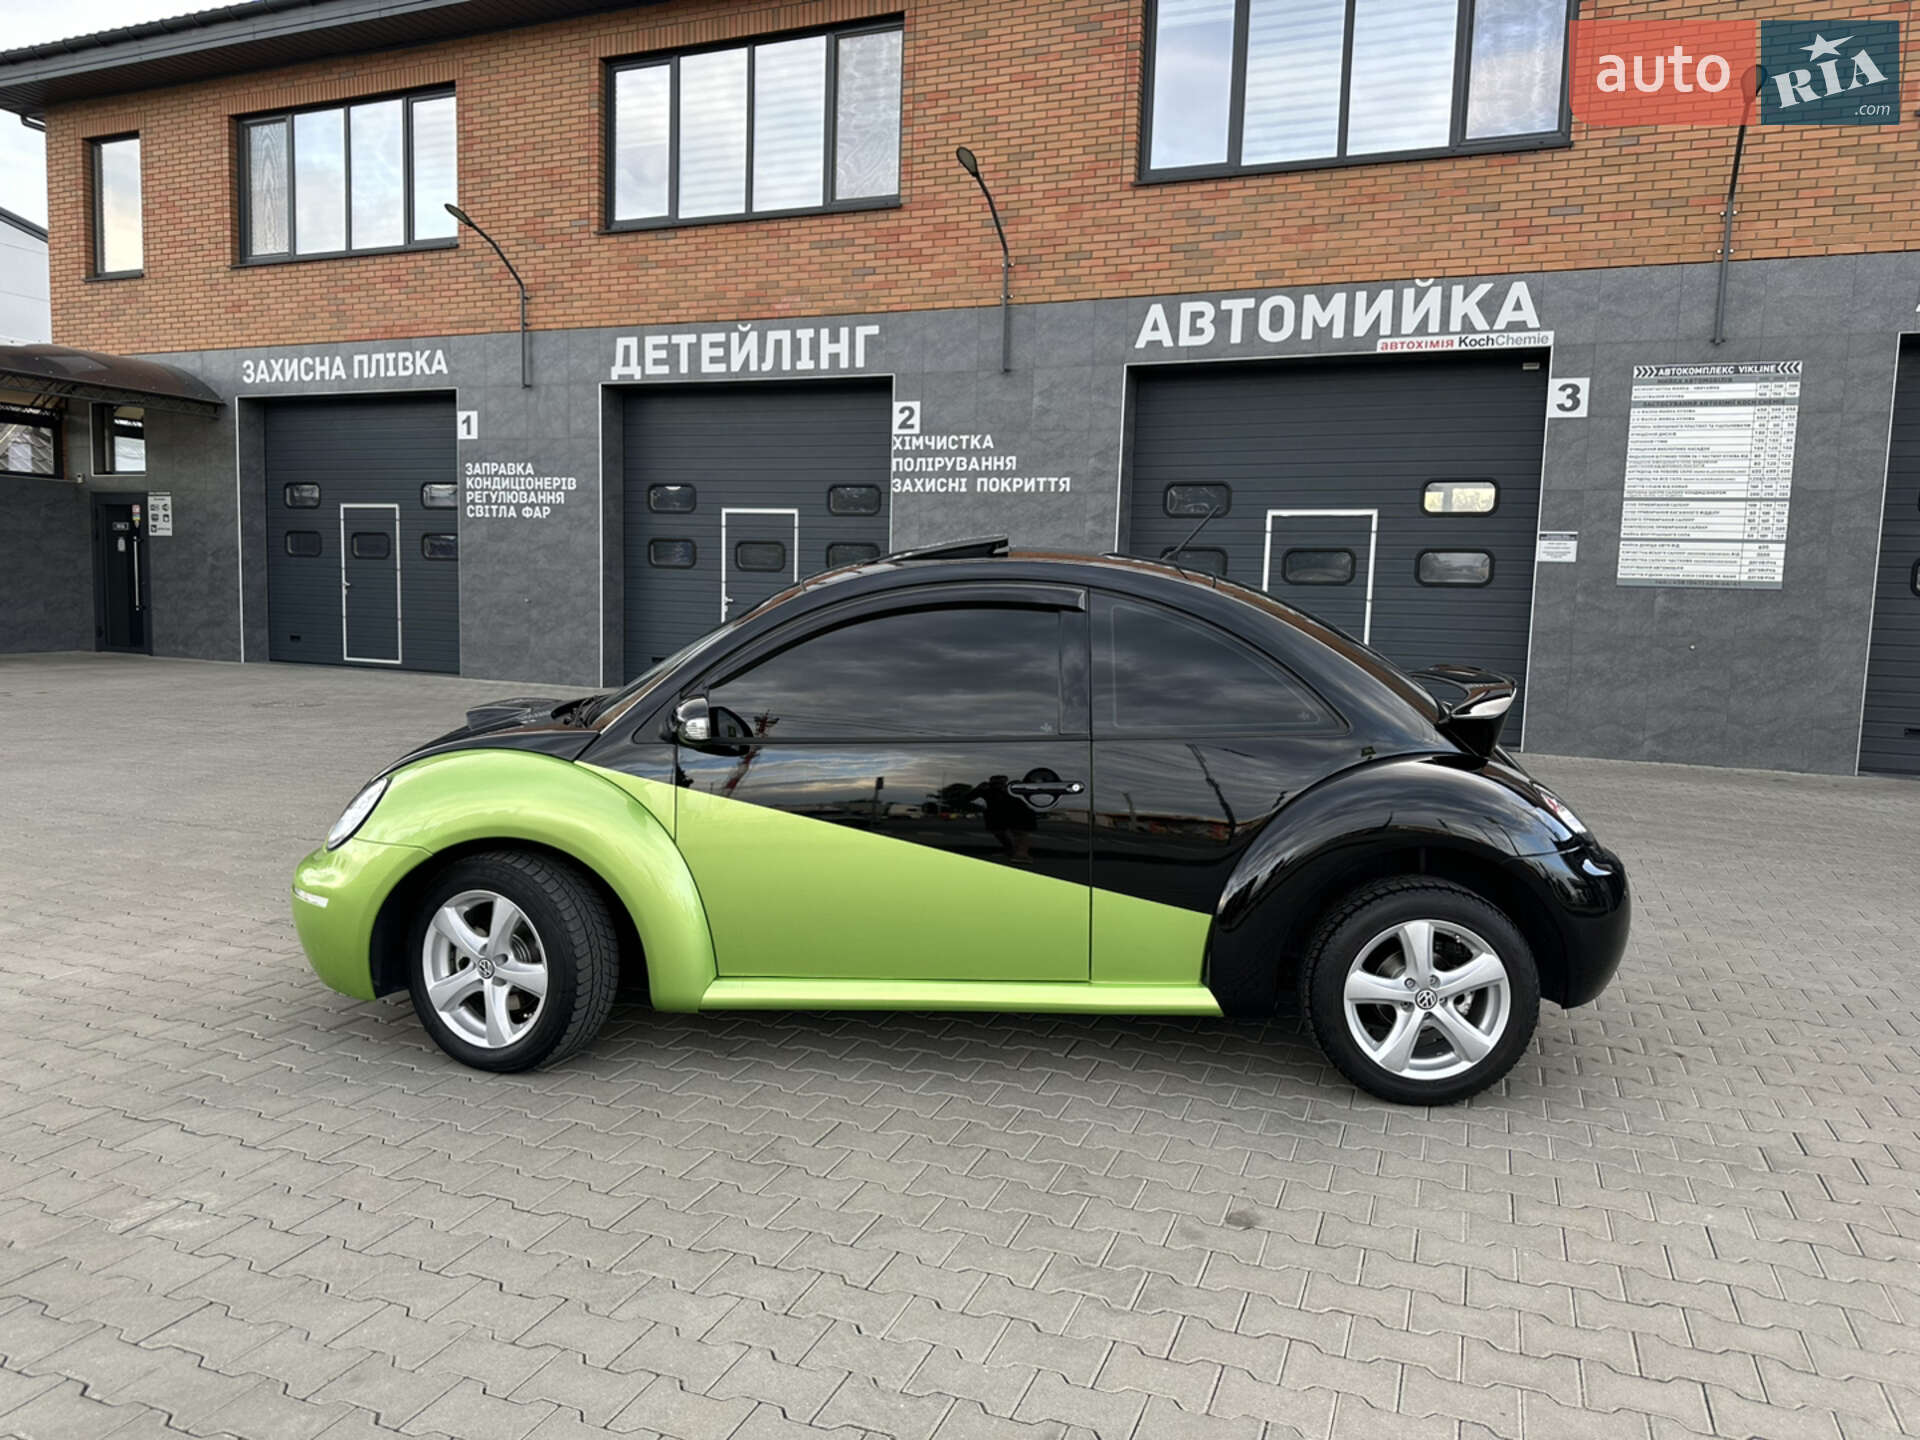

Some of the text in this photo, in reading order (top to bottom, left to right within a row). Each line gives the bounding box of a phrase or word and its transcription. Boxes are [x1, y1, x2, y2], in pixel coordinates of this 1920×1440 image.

[1134, 278, 1541, 348] АВТОМИЙКА
[611, 324, 880, 380] ДЕТЕЙЛІНГ
[242, 349, 449, 384] ЗАХИСНА ПЛІВКА
[1658, 365, 1777, 377] АВТОКОМПЛЕКС VIKLINE
[1556, 383, 1581, 412] 3
[462, 415, 471, 436] 1
[897, 406, 915, 430] 2
[892, 434, 994, 450] ХІМЧИСТКА
[465, 462, 534, 475] ЗАПРАВКА
[892, 456, 1017, 472] ПОЛІРУВАННЯ
[466, 477, 577, 491] КОНДИЦІОНЕРІВ
[892, 477, 1071, 493] ЗАХИСНІ ПОКРИТТЯ
[466, 491, 565, 504] РЕГУЛЮВАННЯ
[466, 505, 551, 518] СВІТЛА ФАР
